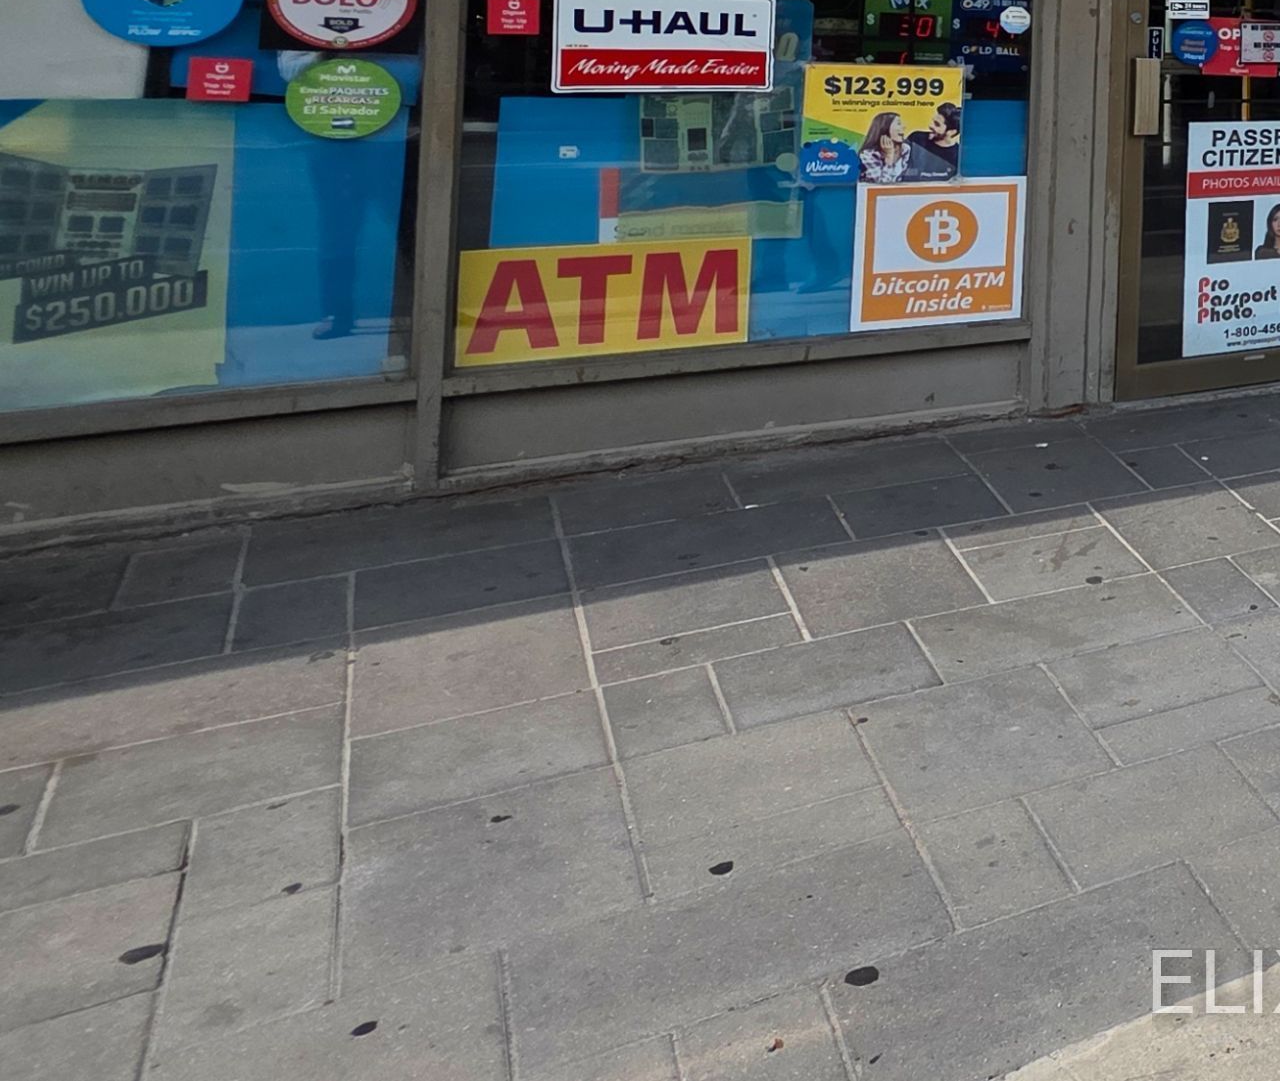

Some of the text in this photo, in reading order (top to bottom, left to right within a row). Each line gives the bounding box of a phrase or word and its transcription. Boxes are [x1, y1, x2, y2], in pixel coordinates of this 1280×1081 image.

[574, 8, 756, 37] U-HAUL
[996, 47, 1020, 56] BALL
[317, 74, 371, 83] Movistar
[568, 58, 641, 80] Moving
[640, 58, 699, 76] Made
[824, 75, 944, 98] $123,999
[303, 106, 380, 116] El Salvador
[842, 99, 880, 107] winnings
[805, 160, 852, 173] Winning
[1202, 176, 1250, 190] PHOTOS
[30, 260, 144, 297] WIN UP TO
[872, 271, 1006, 296] bitcoin ATM
[1198, 277, 1229, 293] Pro
[464, 249, 739, 355] ATM
[905, 293, 973, 313] Inside
[1197, 285, 1277, 309] Passport
